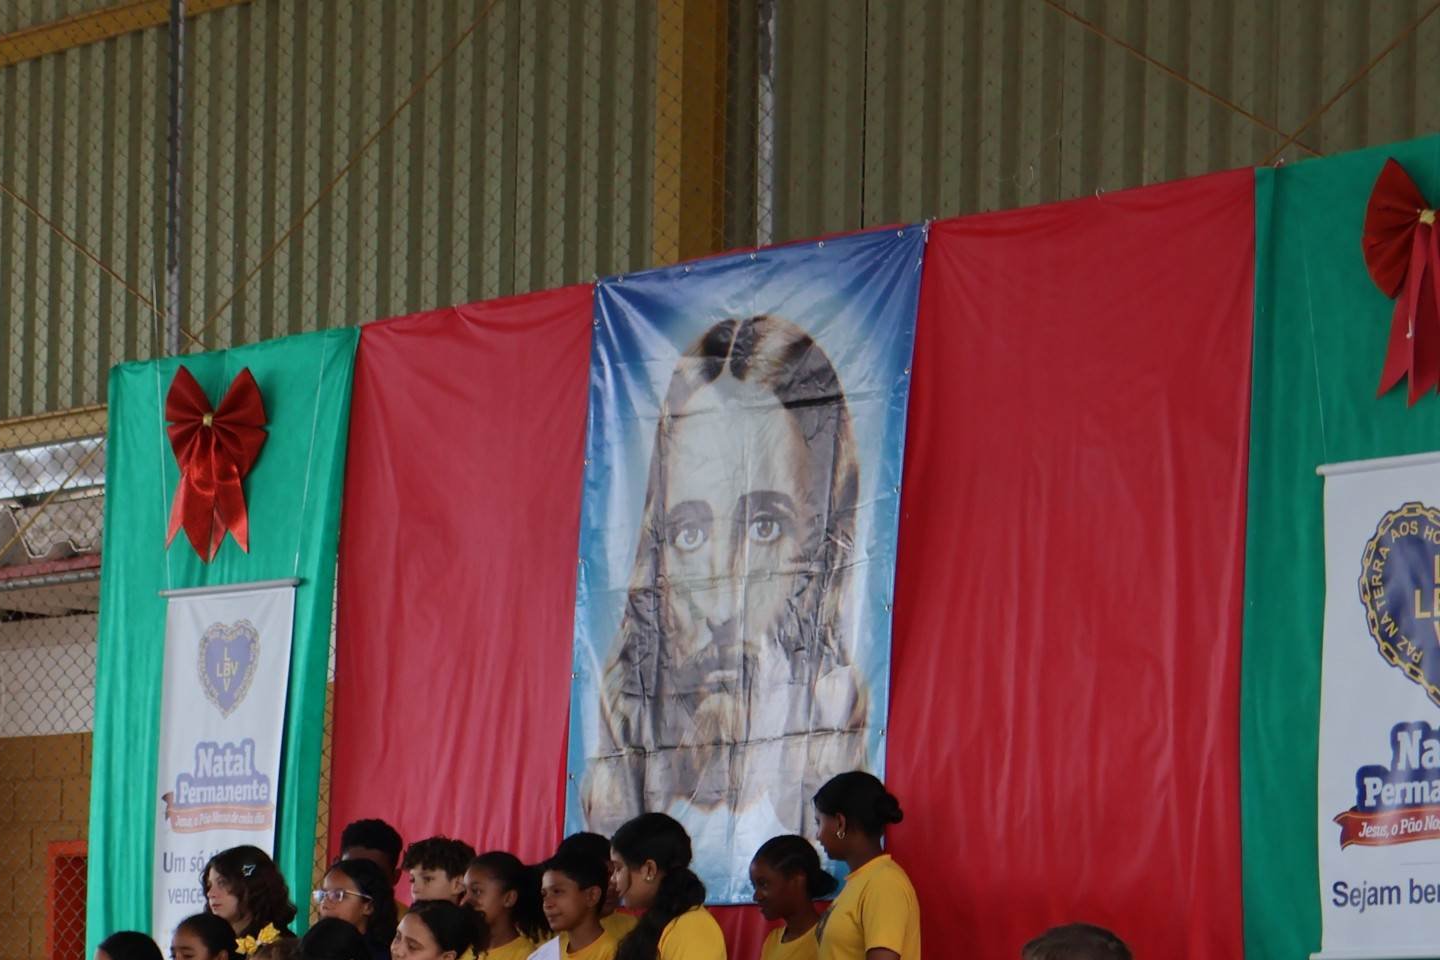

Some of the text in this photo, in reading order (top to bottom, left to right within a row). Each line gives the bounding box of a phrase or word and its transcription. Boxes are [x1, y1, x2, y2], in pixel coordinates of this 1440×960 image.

[1372, 546, 1390, 611] TERRA
[1390, 521, 1419, 543] AOS
[197, 744, 253, 778] Natal
[179, 779, 269, 805] Permanente
[1358, 822, 1389, 839] Jesus,
[1391, 825, 1398, 836] o
[1399, 817, 1423, 835] Pão
[163, 849, 205, 874] Um só
[1332, 880, 1401, 914] Sejam
